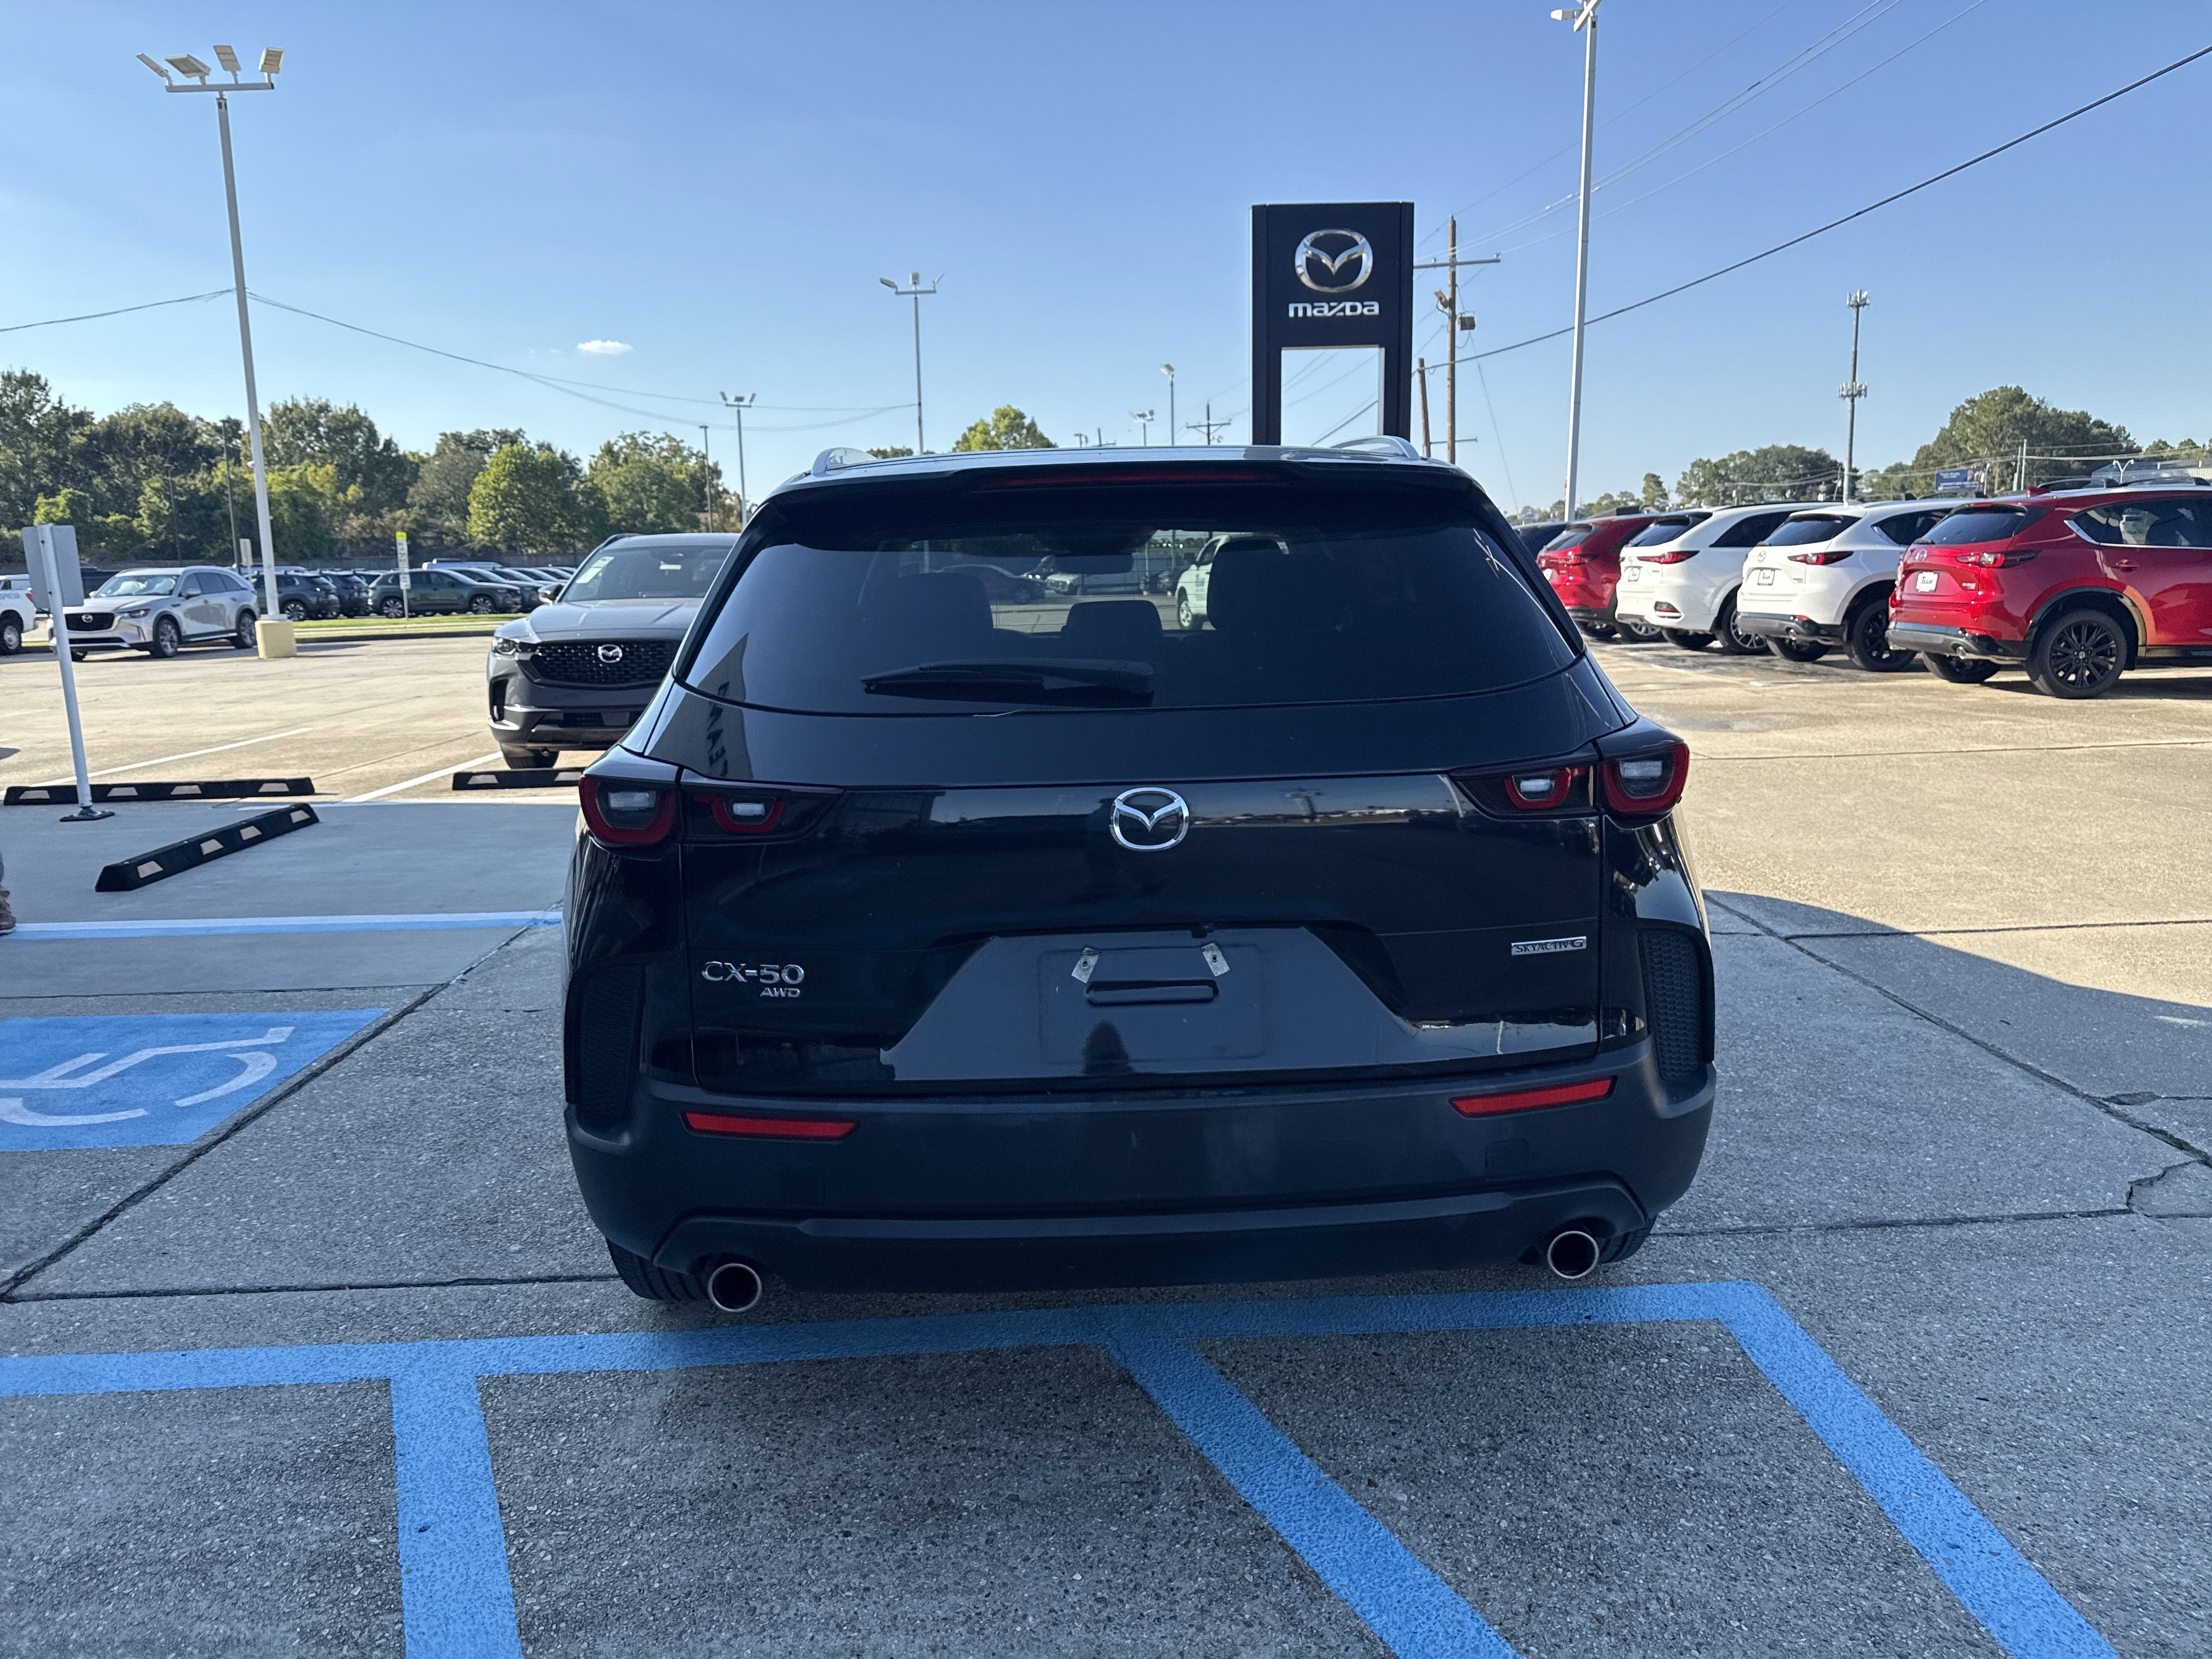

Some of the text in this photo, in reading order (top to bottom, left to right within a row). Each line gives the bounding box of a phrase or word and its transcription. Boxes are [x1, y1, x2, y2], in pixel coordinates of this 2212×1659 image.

[1288, 301, 1380, 318] mazda
[702, 961, 805, 984] CX-50
[760, 988, 803, 998] AWD
